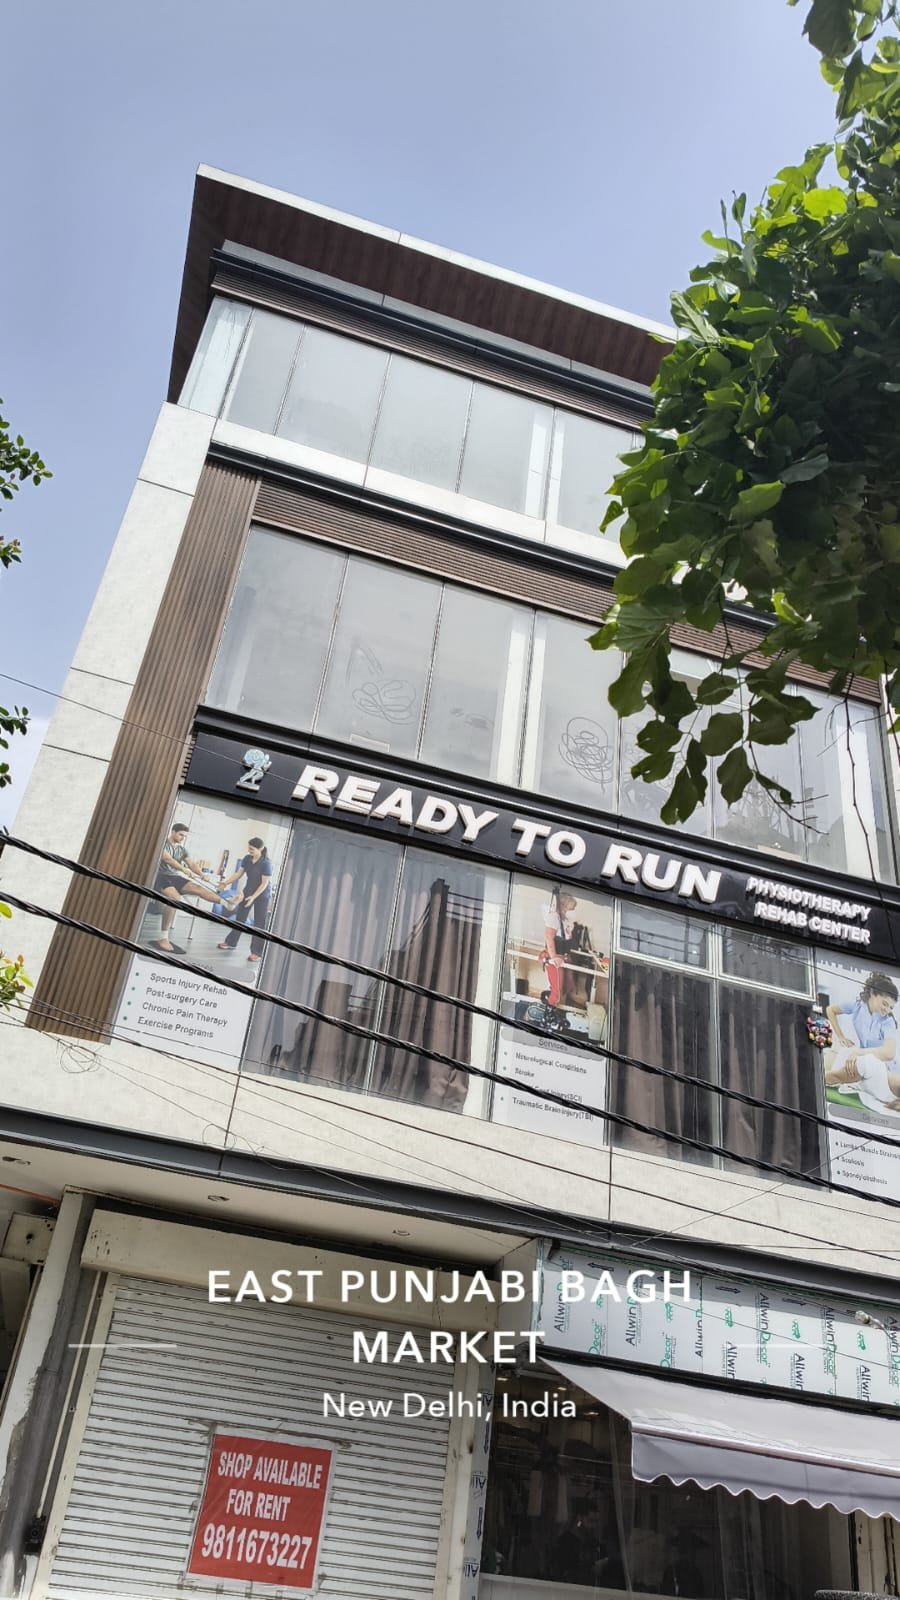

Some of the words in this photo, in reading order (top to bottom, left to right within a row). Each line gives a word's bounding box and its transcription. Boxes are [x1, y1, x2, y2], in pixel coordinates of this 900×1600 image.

[292, 765, 499, 842] READY
[512, 818, 586, 866] TO
[602, 844, 721, 903] RUN
[746, 876, 871, 921] PHYSIOTHERAPY
[754, 901, 807, 928] REHAB
[809, 916, 871, 945] CENTER
[146, 986, 197, 1006] Post-surgery
[199, 998, 217, 1008] Care
[150, 973, 176, 985] Sports
[178, 978, 201, 991] Injury
[203, 983, 227, 996] Rehab
[138, 1016, 173, 1030] Exercise
[175, 1023, 214, 1038] Programs
[142, 1002, 174, 1015] Chronic
[176, 1008, 194, 1019] Pain
[196, 1013, 228, 1027] Therapy
[218, 1451, 253, 1479] SHOP
[253, 1456, 323, 1489] AVAILABLE
[226, 1488, 254, 1517] FOR
[254, 1492, 291, 1521] RENT
[201, 1522, 312, 1570] 9811673227
